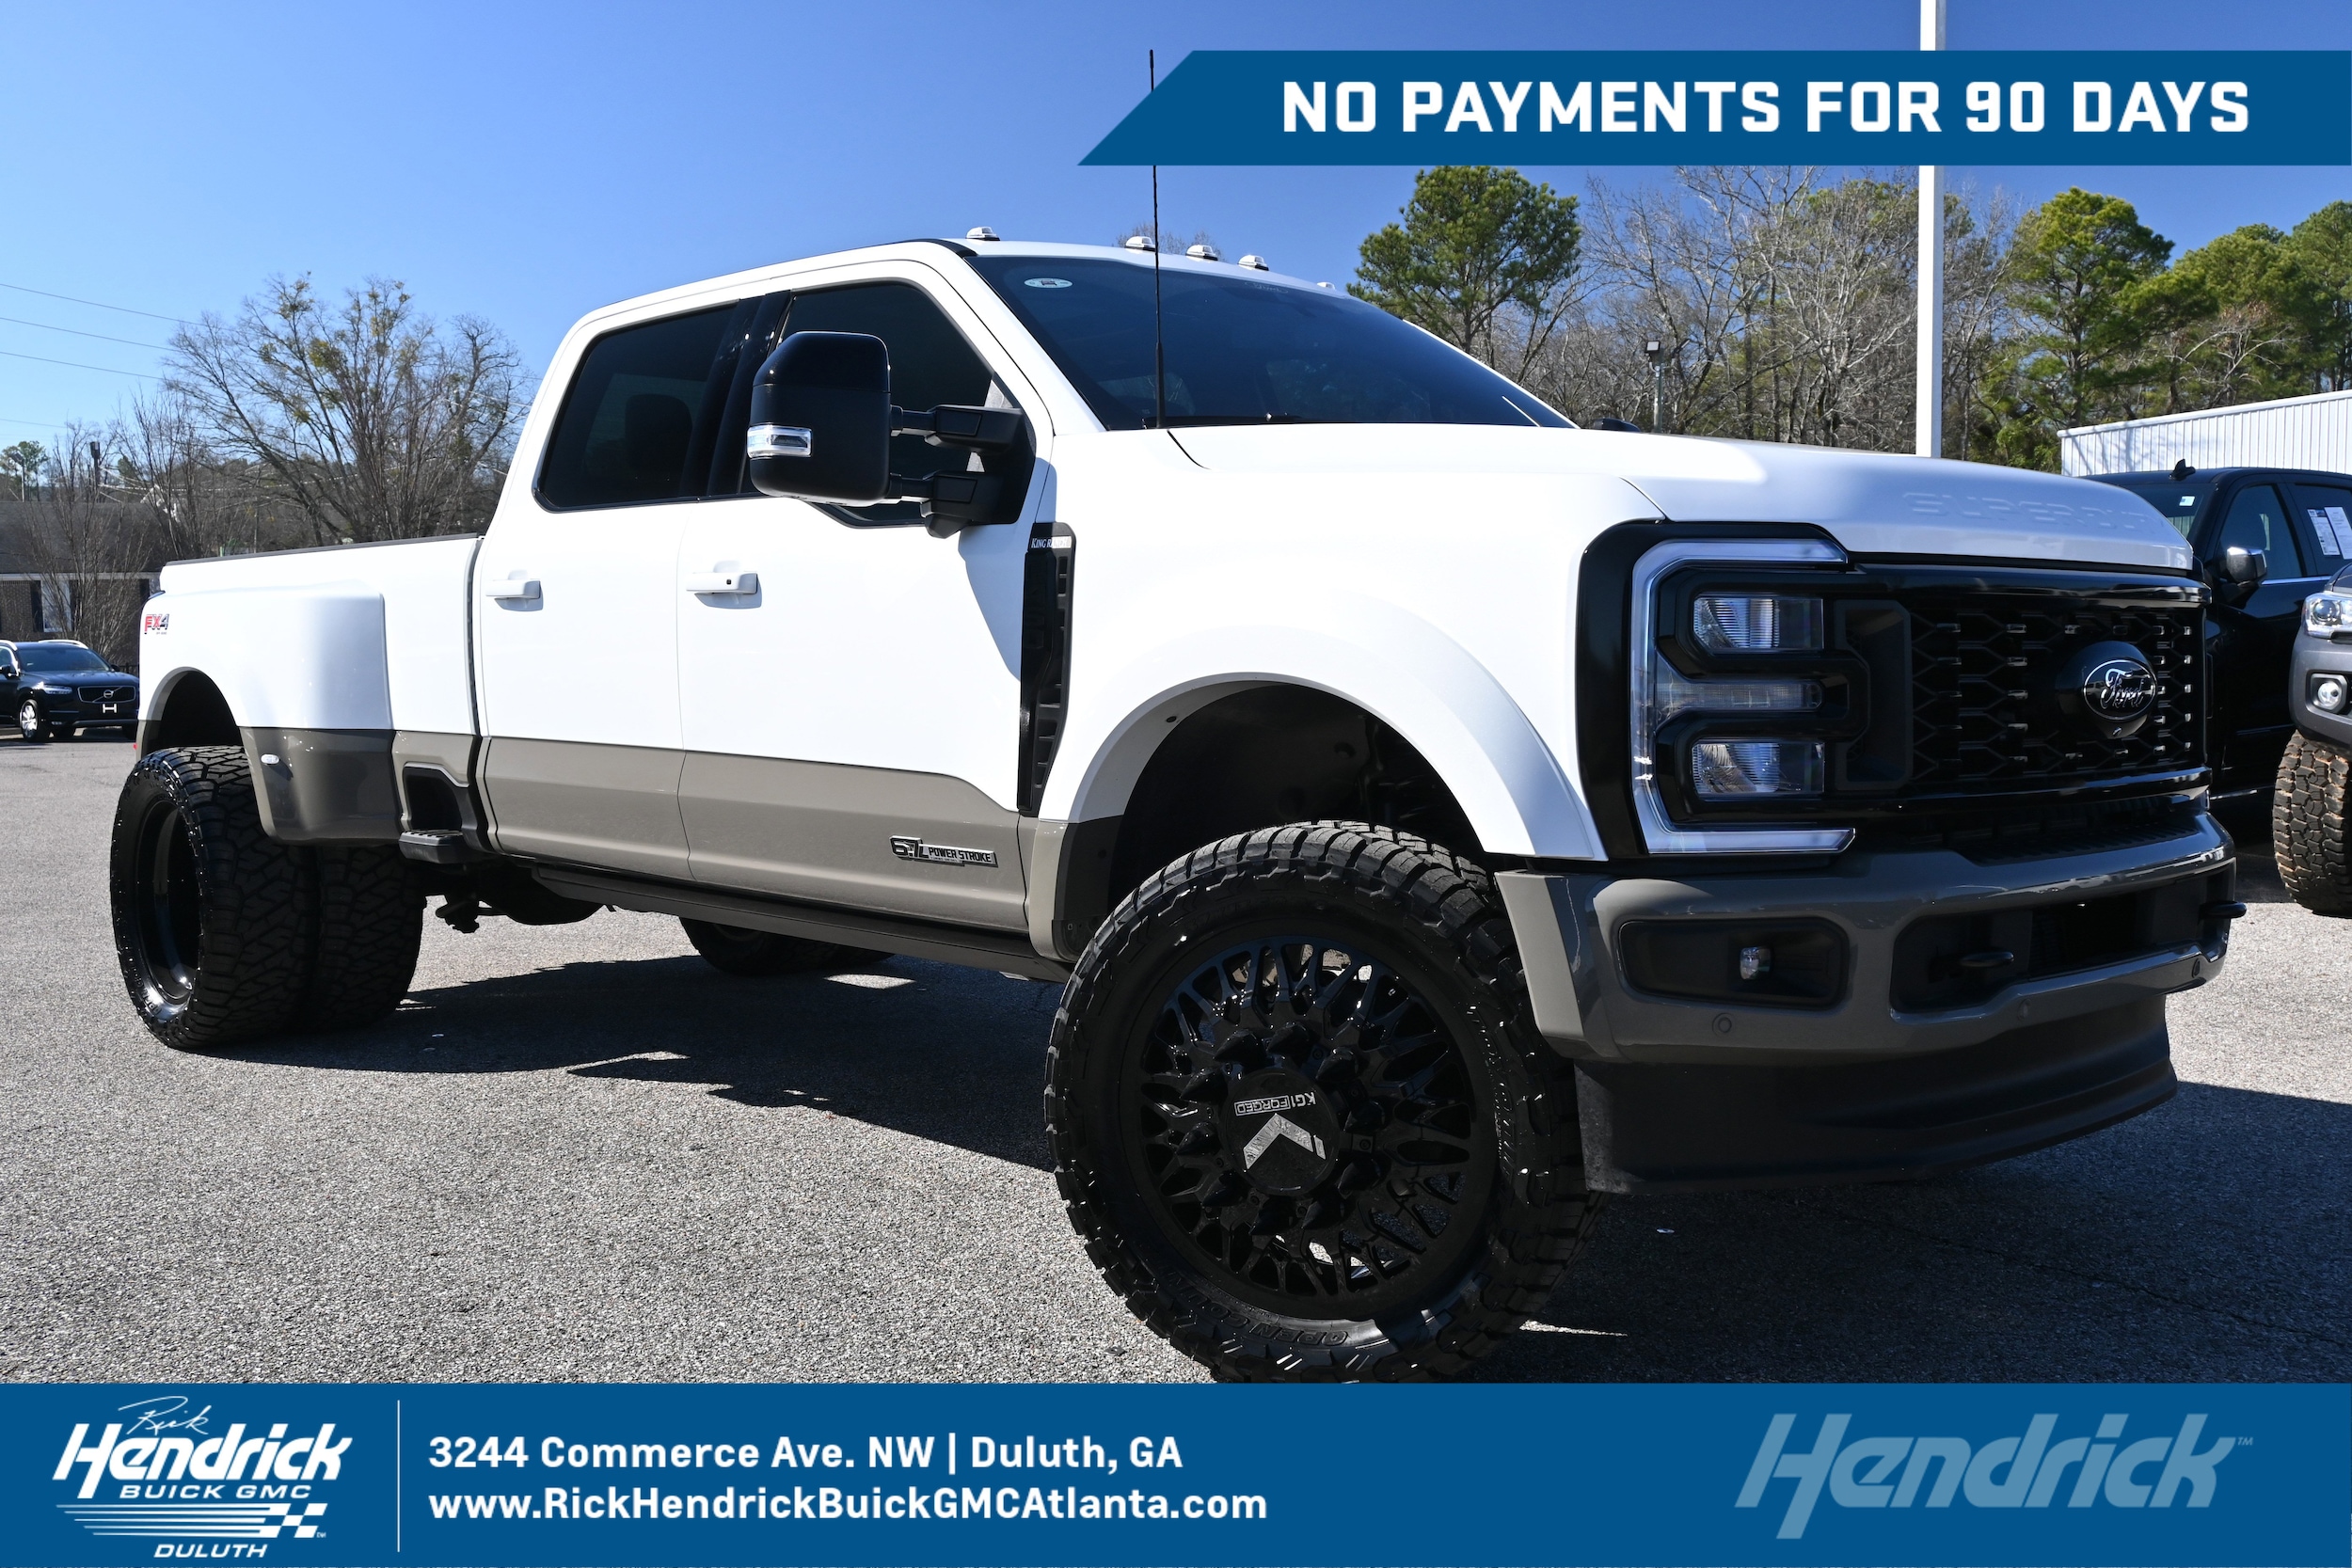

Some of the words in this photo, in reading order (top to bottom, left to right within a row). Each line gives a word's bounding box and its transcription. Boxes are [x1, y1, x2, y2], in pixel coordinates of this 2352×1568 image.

[1030, 538, 1046, 548] KING
[144, 613, 170, 634] FX4
[2100, 668, 2149, 709] Ford
[928, 847, 958, 860] POWER
[958, 849, 993, 863] STROKE
[1236, 1097, 1289, 1114] FORGED
[1248, 1321, 1349, 1347] OPEN
